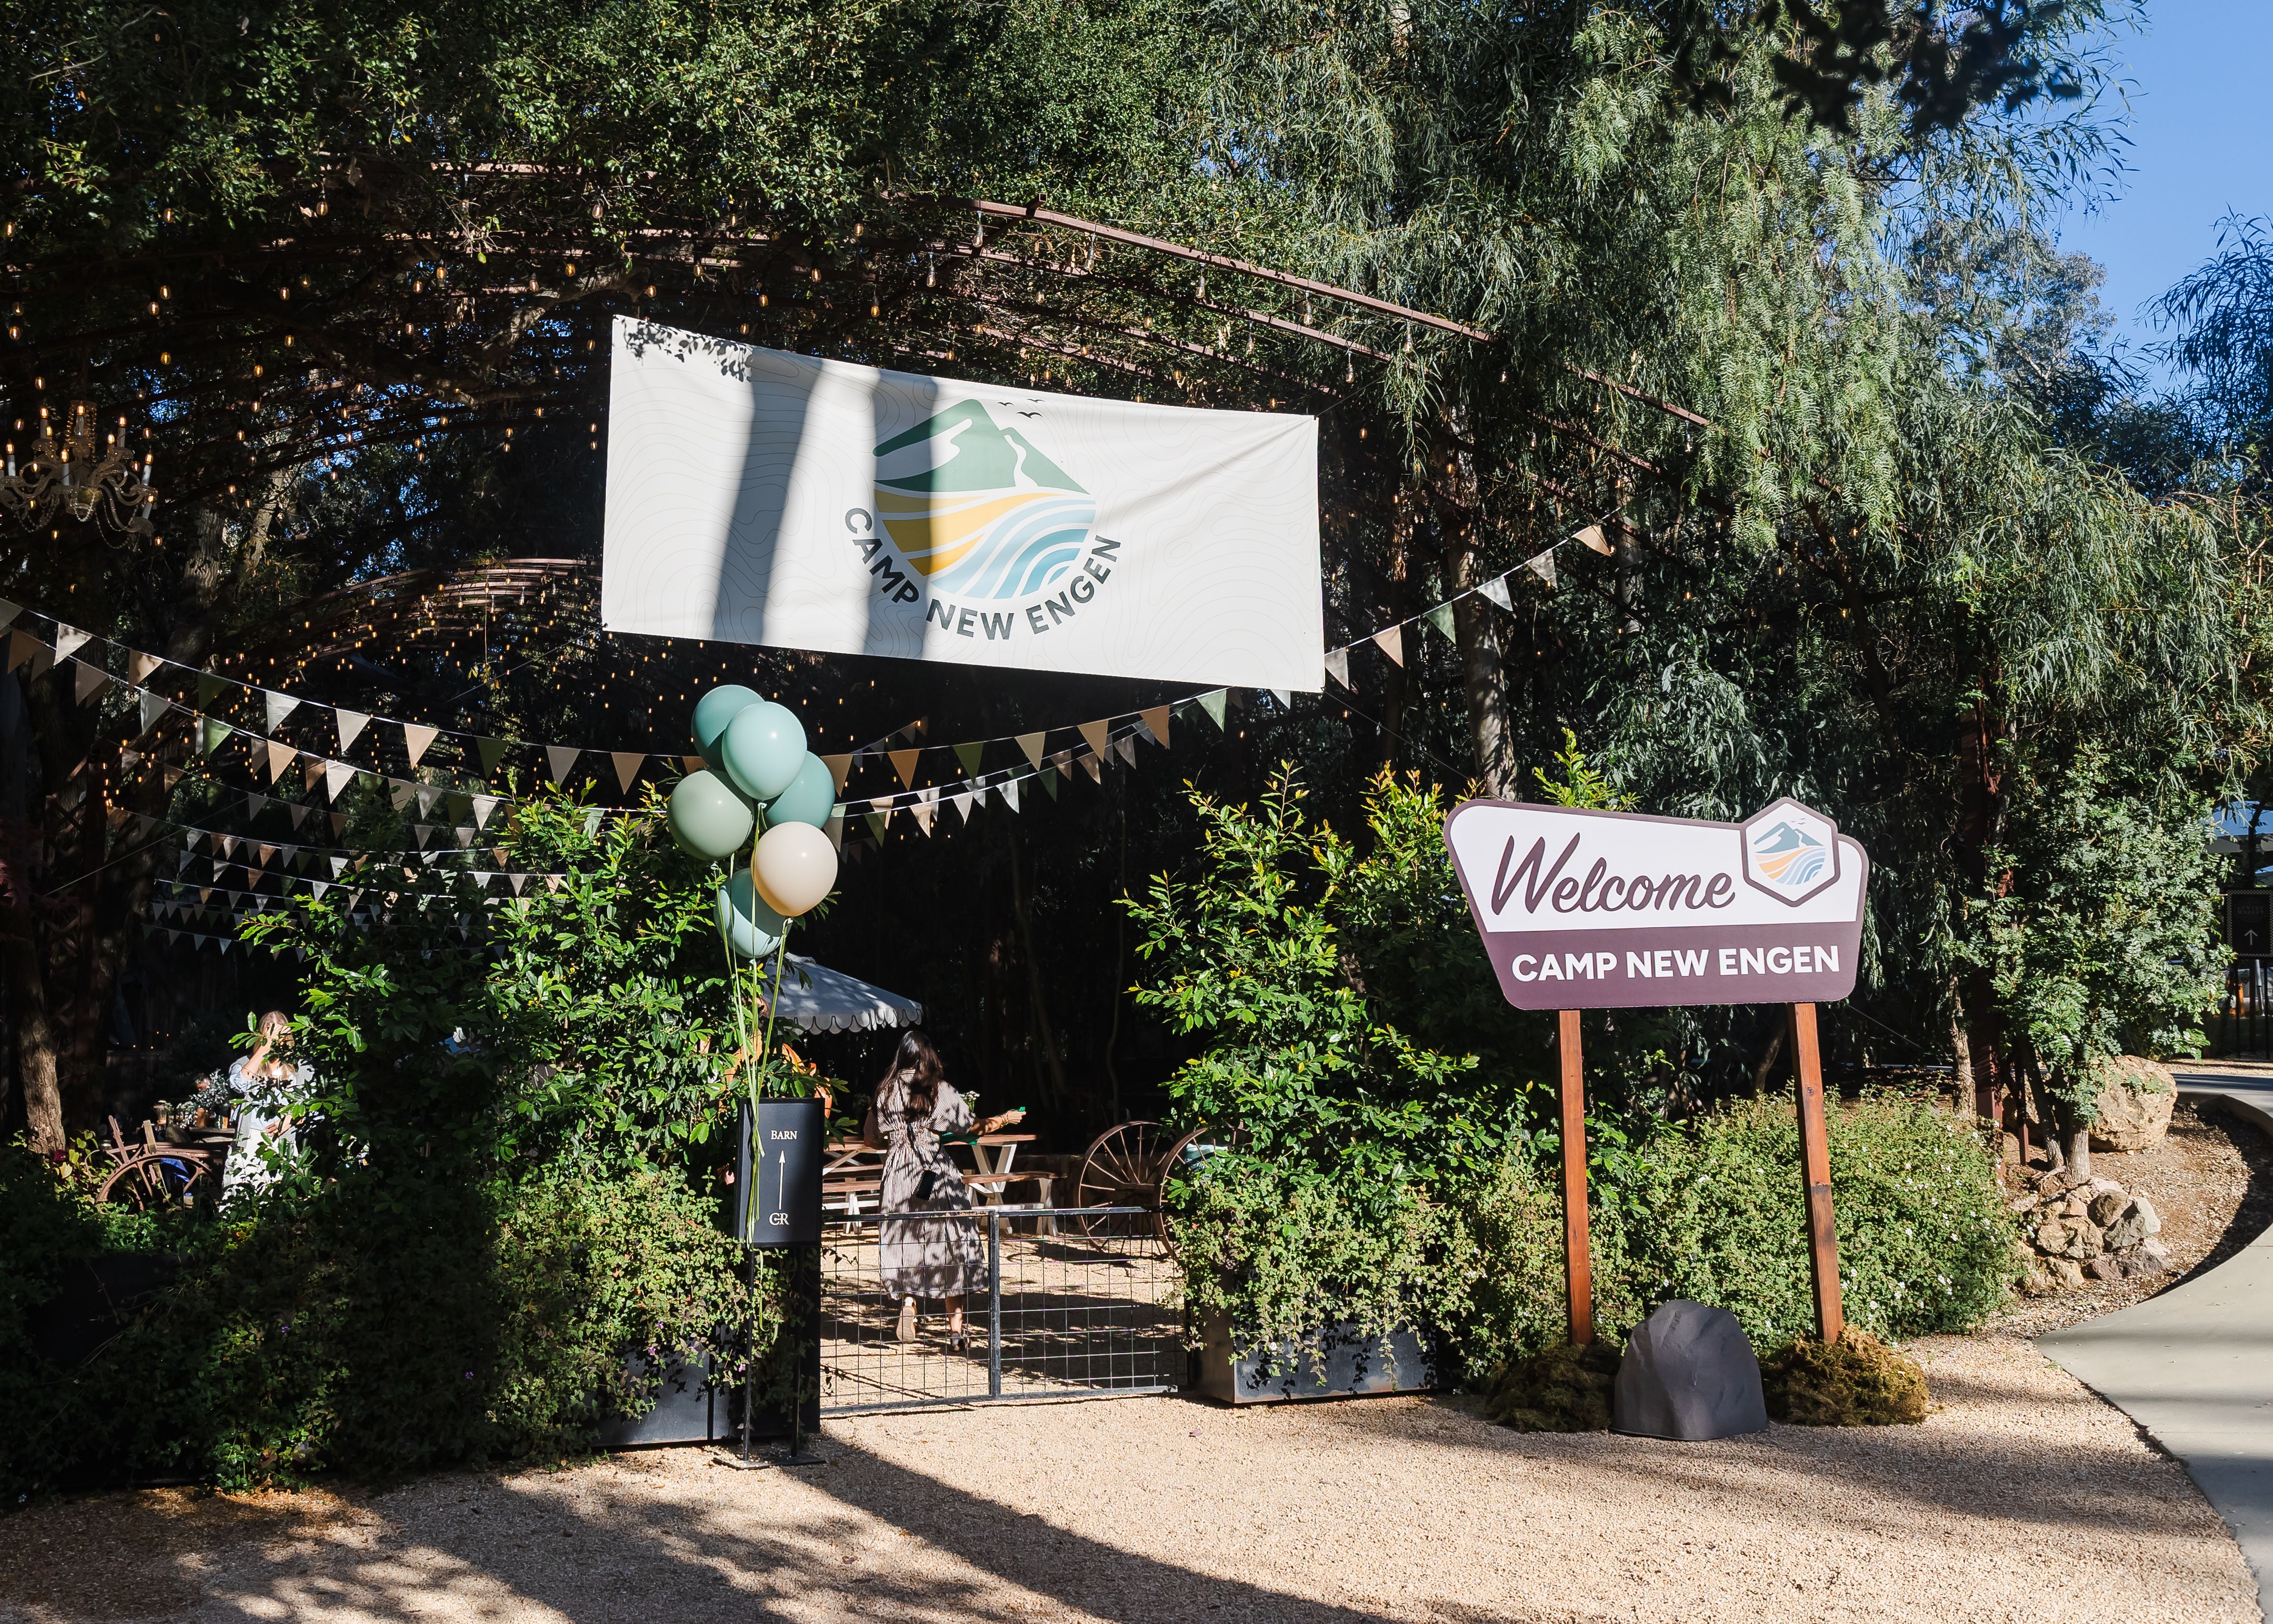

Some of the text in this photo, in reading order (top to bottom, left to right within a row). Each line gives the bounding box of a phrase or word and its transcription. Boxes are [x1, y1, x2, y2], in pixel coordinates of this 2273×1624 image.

[845, 507, 1121, 640] CAMP NEW ENGEN
[1491, 832, 1735, 915] Welcome
[1512, 945, 1840, 982] CAMP NEW ENGEN
[770, 1130, 798, 1140] BARN
